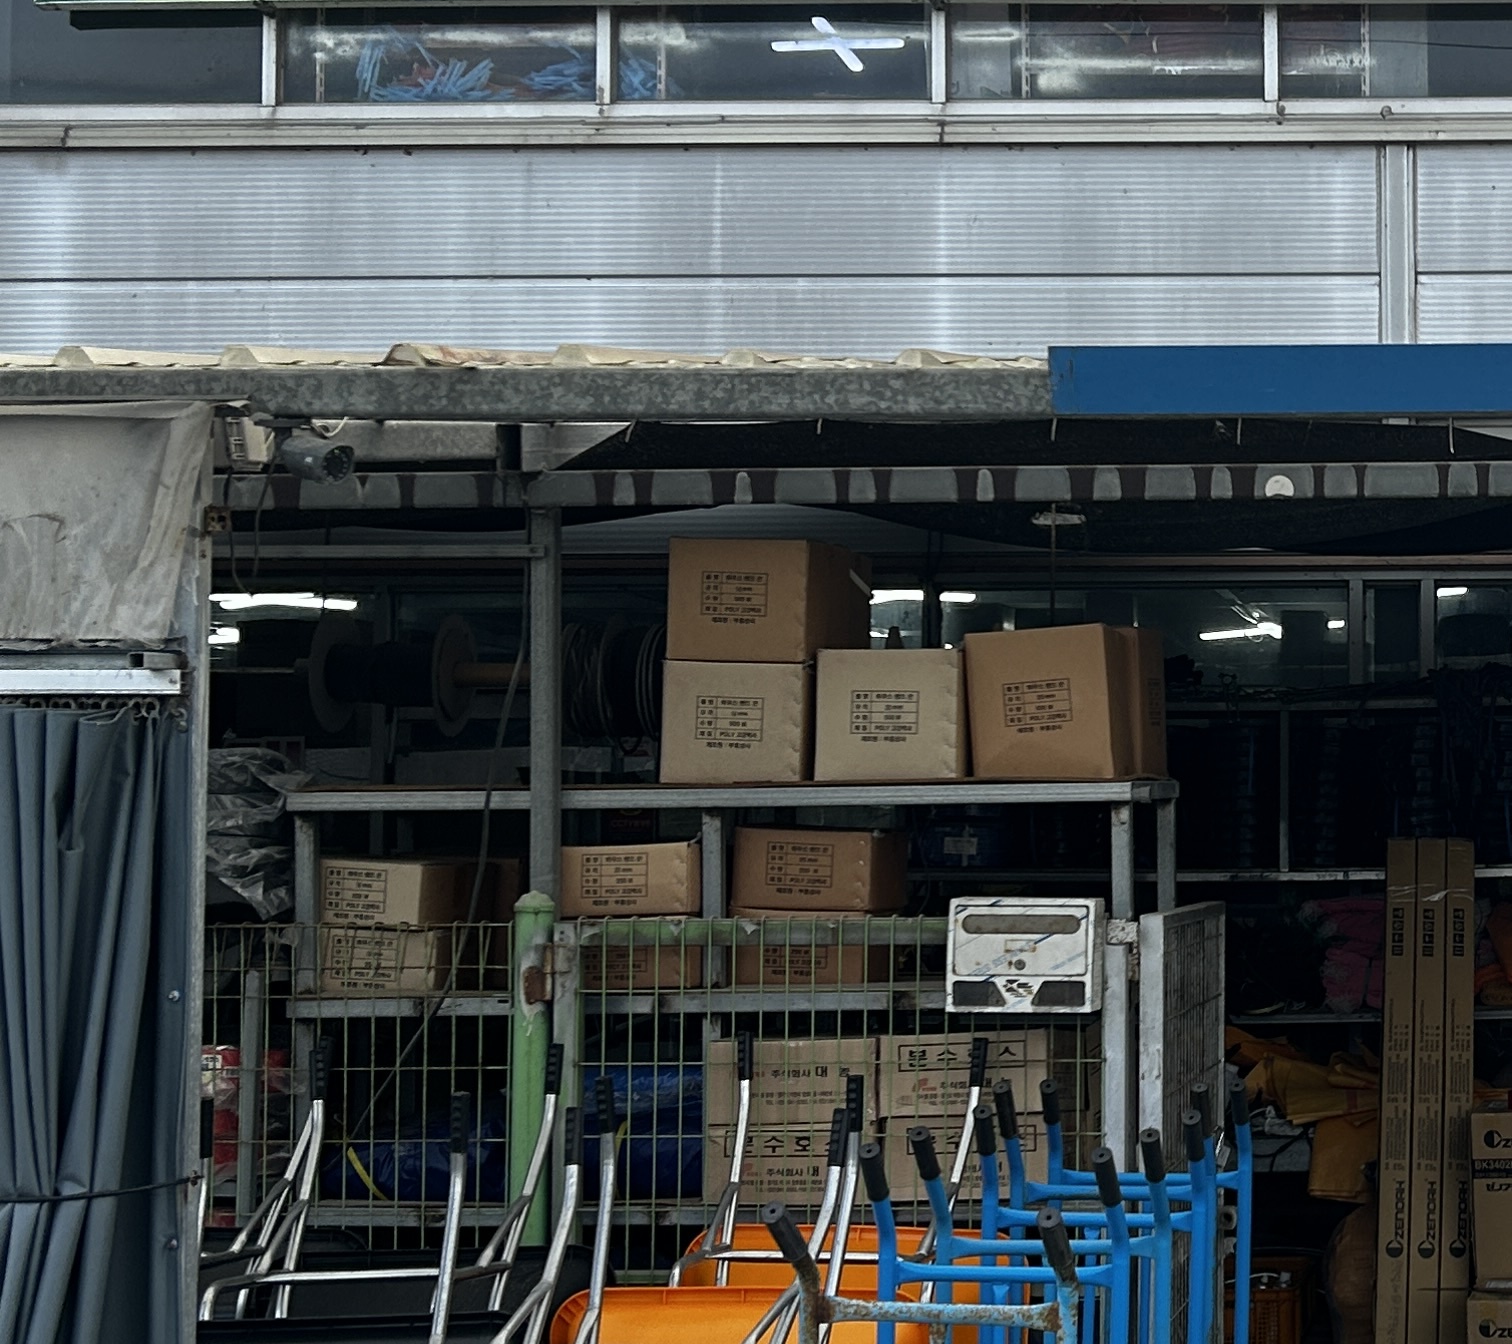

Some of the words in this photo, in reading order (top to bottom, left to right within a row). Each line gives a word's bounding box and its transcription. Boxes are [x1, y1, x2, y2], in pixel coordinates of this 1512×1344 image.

[908, 1046, 1016, 1067] 분수스
[1395, 1180, 1405, 1240] ZENOAH
[1426, 1180, 1437, 1241] ZENOAH
